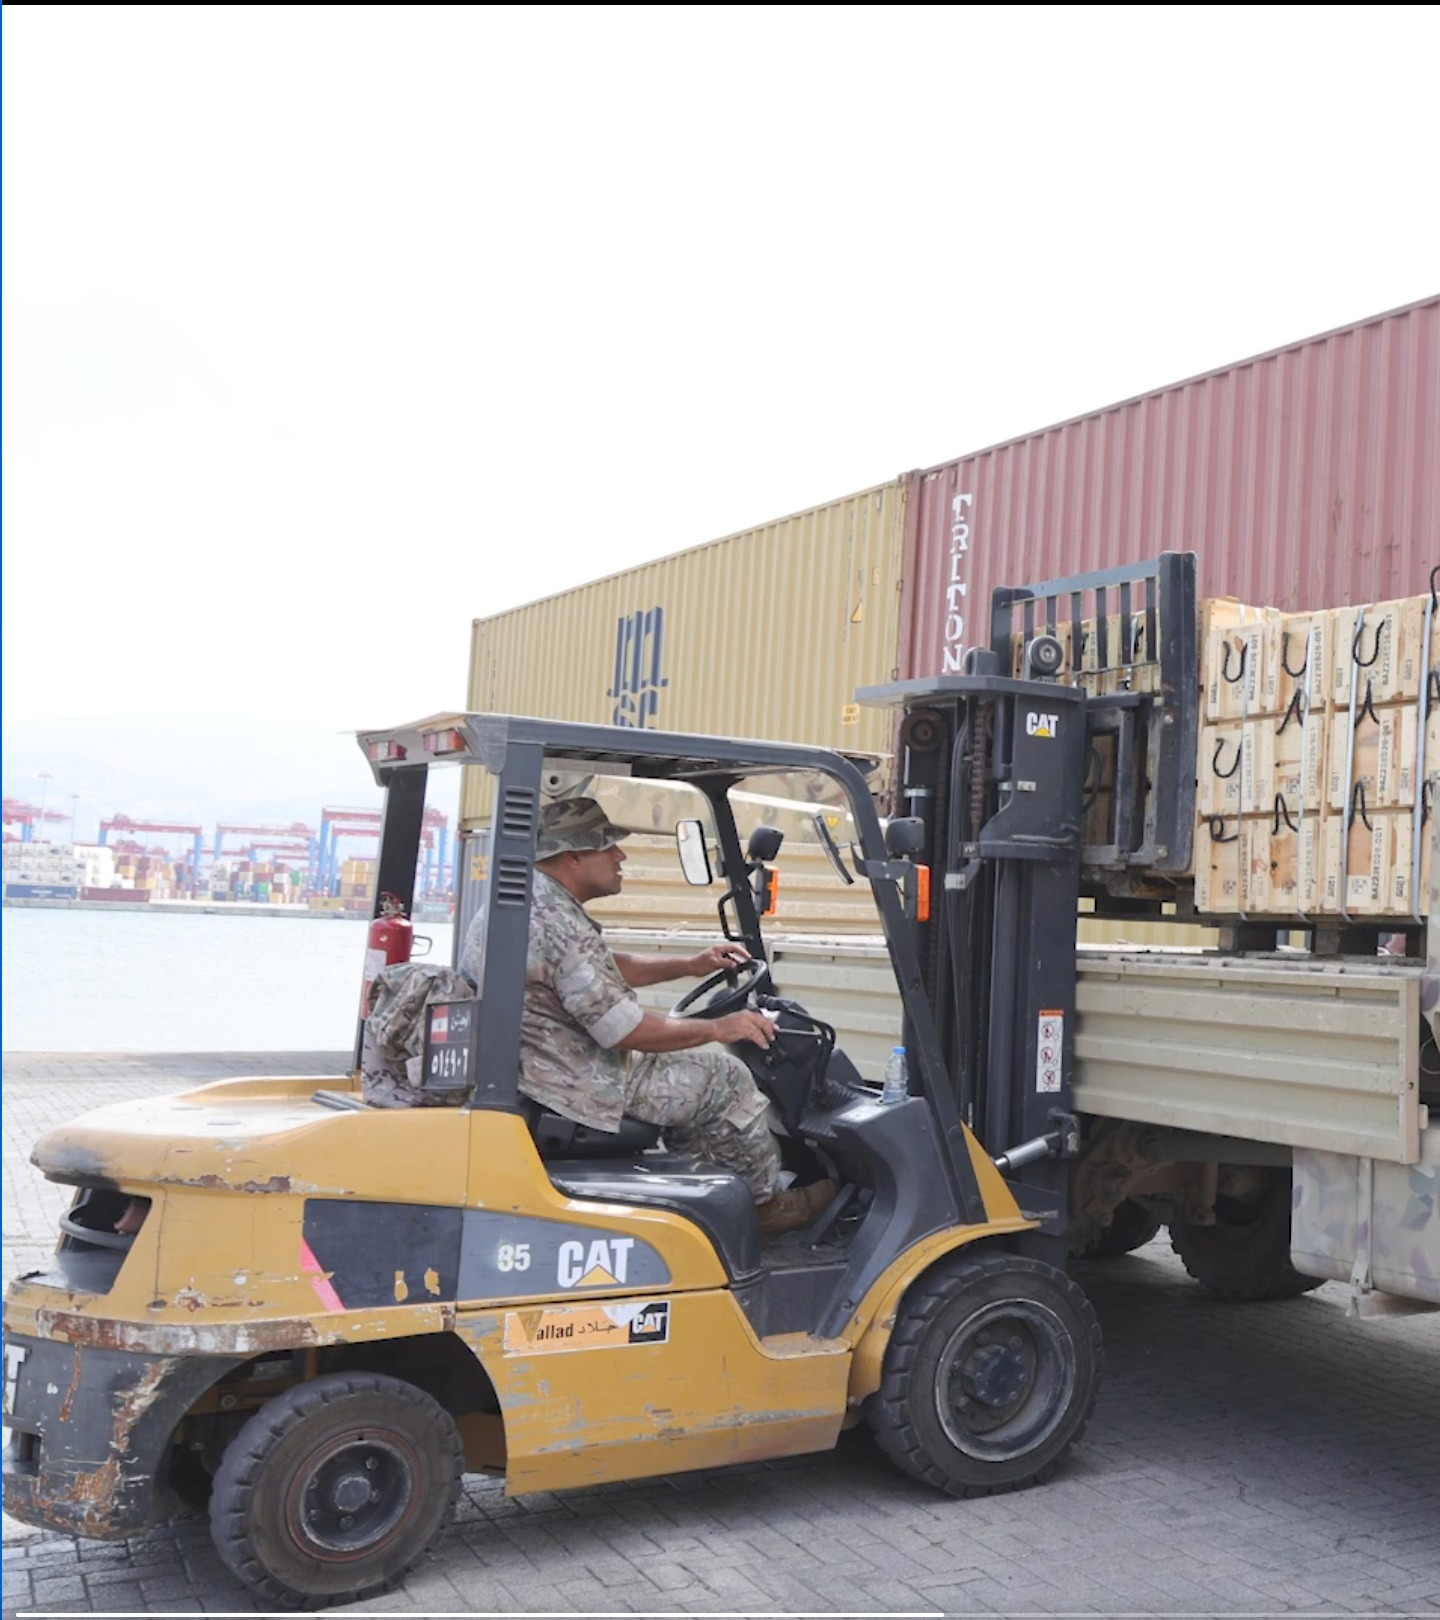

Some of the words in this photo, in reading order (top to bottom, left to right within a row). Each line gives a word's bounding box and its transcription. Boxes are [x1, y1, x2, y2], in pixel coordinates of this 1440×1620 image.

[941, 493, 973, 674] TRITON
[1026, 711, 1059, 738] CAT
[497, 1243, 531, 1272] 85
[557, 1238, 634, 1288] CAT
[535, 1323, 574, 1341] allad
[632, 1312, 665, 1334] CAT
